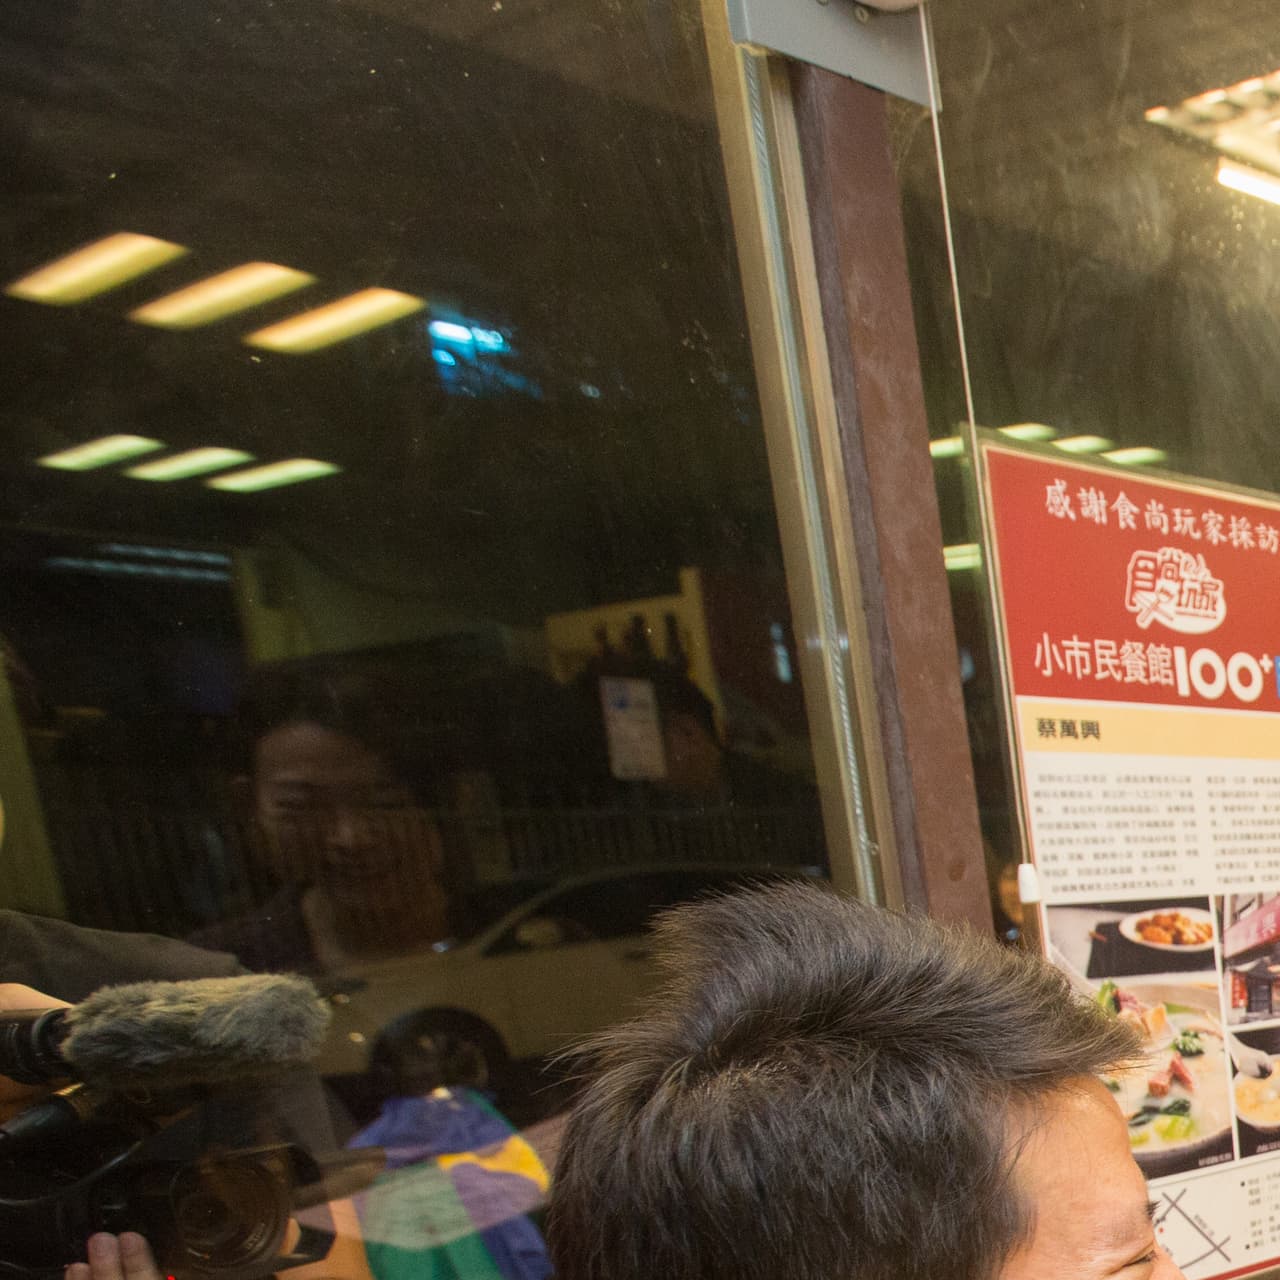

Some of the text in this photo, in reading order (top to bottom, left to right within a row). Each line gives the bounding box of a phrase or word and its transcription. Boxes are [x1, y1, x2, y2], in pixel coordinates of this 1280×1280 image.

[1045, 479, 1280, 554] 感謝食尚玩家採訪
[1036, 717, 1101, 741] 蔡萬興
